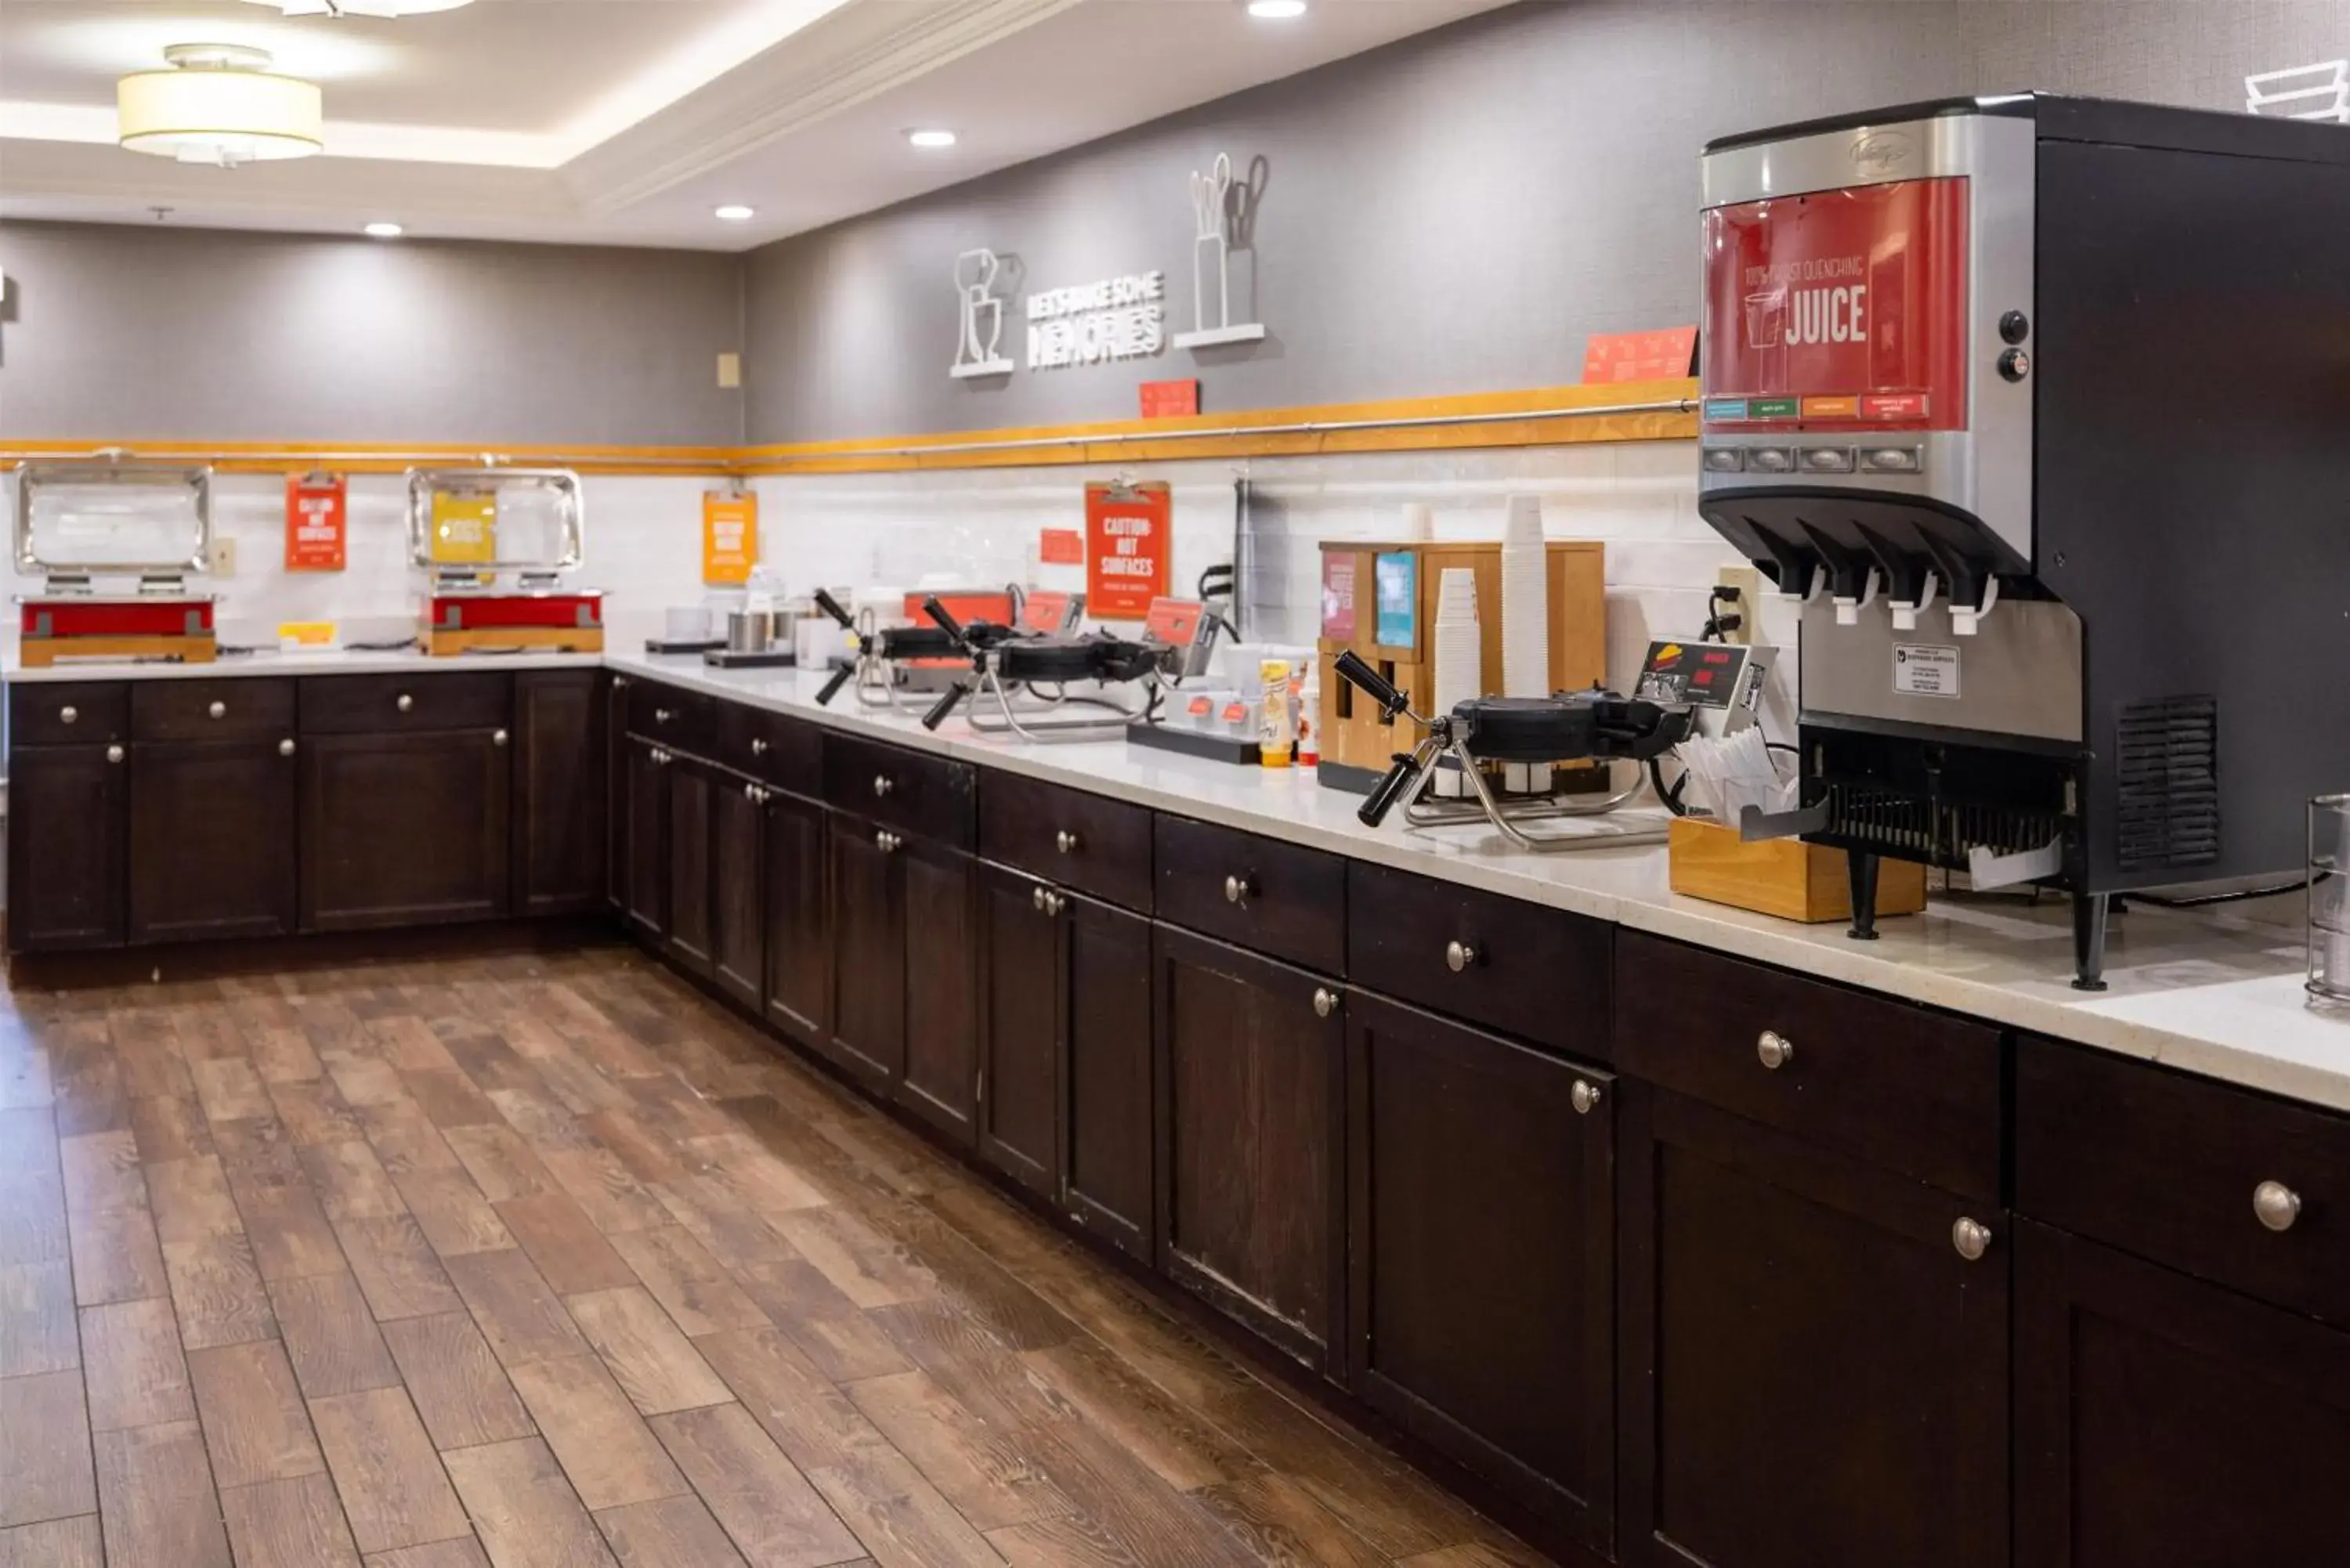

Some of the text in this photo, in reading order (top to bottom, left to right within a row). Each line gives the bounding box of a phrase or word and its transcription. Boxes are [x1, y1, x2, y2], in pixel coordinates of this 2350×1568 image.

[1803, 255, 1864, 280] QUENCHING
[1785, 284, 1867, 346] JUICE
[1028, 305, 1162, 367] MEMORIES
[1116, 537, 1137, 556] HOT
[1100, 555, 1154, 577] SURFACES
